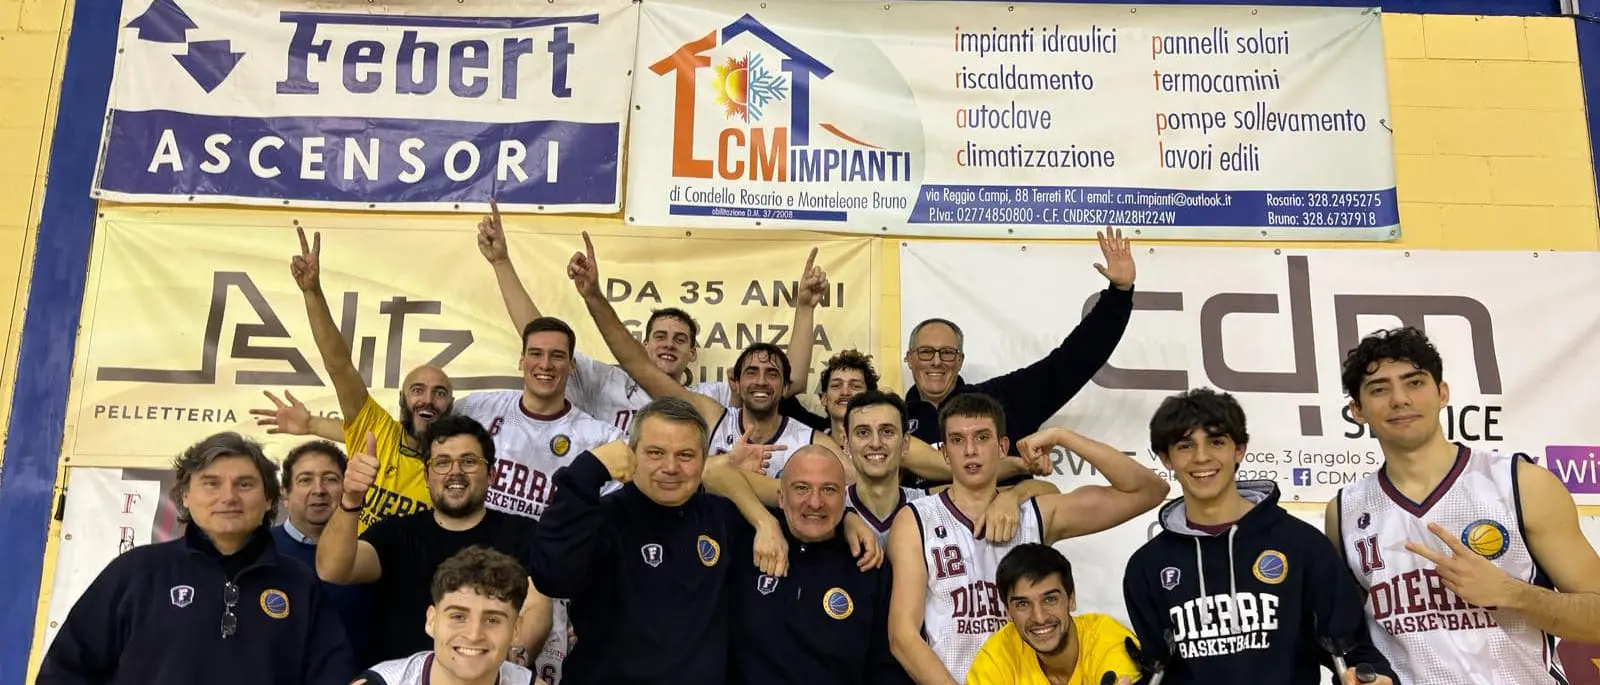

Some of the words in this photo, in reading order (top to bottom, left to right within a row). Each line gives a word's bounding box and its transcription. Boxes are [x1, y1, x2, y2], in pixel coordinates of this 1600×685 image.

[276, 12, 599, 98] Febert
[955, 27, 1035, 58] impianti
[1042, 26, 1117, 54] idraulici
[1152, 27, 1230, 60] pannelli
[1236, 31, 1290, 56] solari
[955, 65, 1094, 91] riscaldamento
[1153, 68, 1280, 93] termocamini
[956, 101, 1051, 130] autoclave
[1156, 111, 1226, 135] pompe
[1233, 103, 1366, 133] sollevamento
[147, 129, 559, 183] ASCENSORI
[790, 149, 911, 183] IMPIANTI
[956, 143, 1115, 169] climatizzazione
[1158, 143, 1213, 171] lavori
[1219, 144, 1260, 172] edili
[669, 186, 680, 202] di
[685, 186, 735, 205] Condello
[740, 189, 782, 207] Rosario
[787, 196, 794, 207] e
[798, 192, 868, 209] Monteleone
[873, 193, 907, 210] Bruno
[925, 188, 940, 202] via
[943, 187, 976, 205] Reggio
[978, 188, 1012, 205] Campi,
[1015, 188, 1029, 202] 88
[1031, 188, 1062, 203] Terreti
[1064, 188, 1077, 203] RC
[1116, 191, 1232, 208] c.m.impianti@outlook.it
[1266, 193, 1305, 207] Rosario:
[1308, 193, 1382, 208] 328.2495275
[929, 207, 954, 222] P.Iva:
[956, 207, 1033, 222] 02774850800
[1043, 208, 1060, 223] C.F.
[1267, 211, 1300, 226] Bruno:
[1302, 212, 1376, 226] 328.6737918
[606, 278, 662, 303] DA
[680, 280, 724, 304] 35
[94, 405, 237, 423] PELLETTERIA
[1342, 404, 1503, 441] SICE
[1283, 450, 1292, 463] 3
[1299, 450, 1361, 467] (angolo
[1556, 452, 1600, 484] wi
[931, 545, 966, 581] 12
[1354, 533, 1385, 576] 11
[1179, 631, 1271, 659] BASKETBALL
